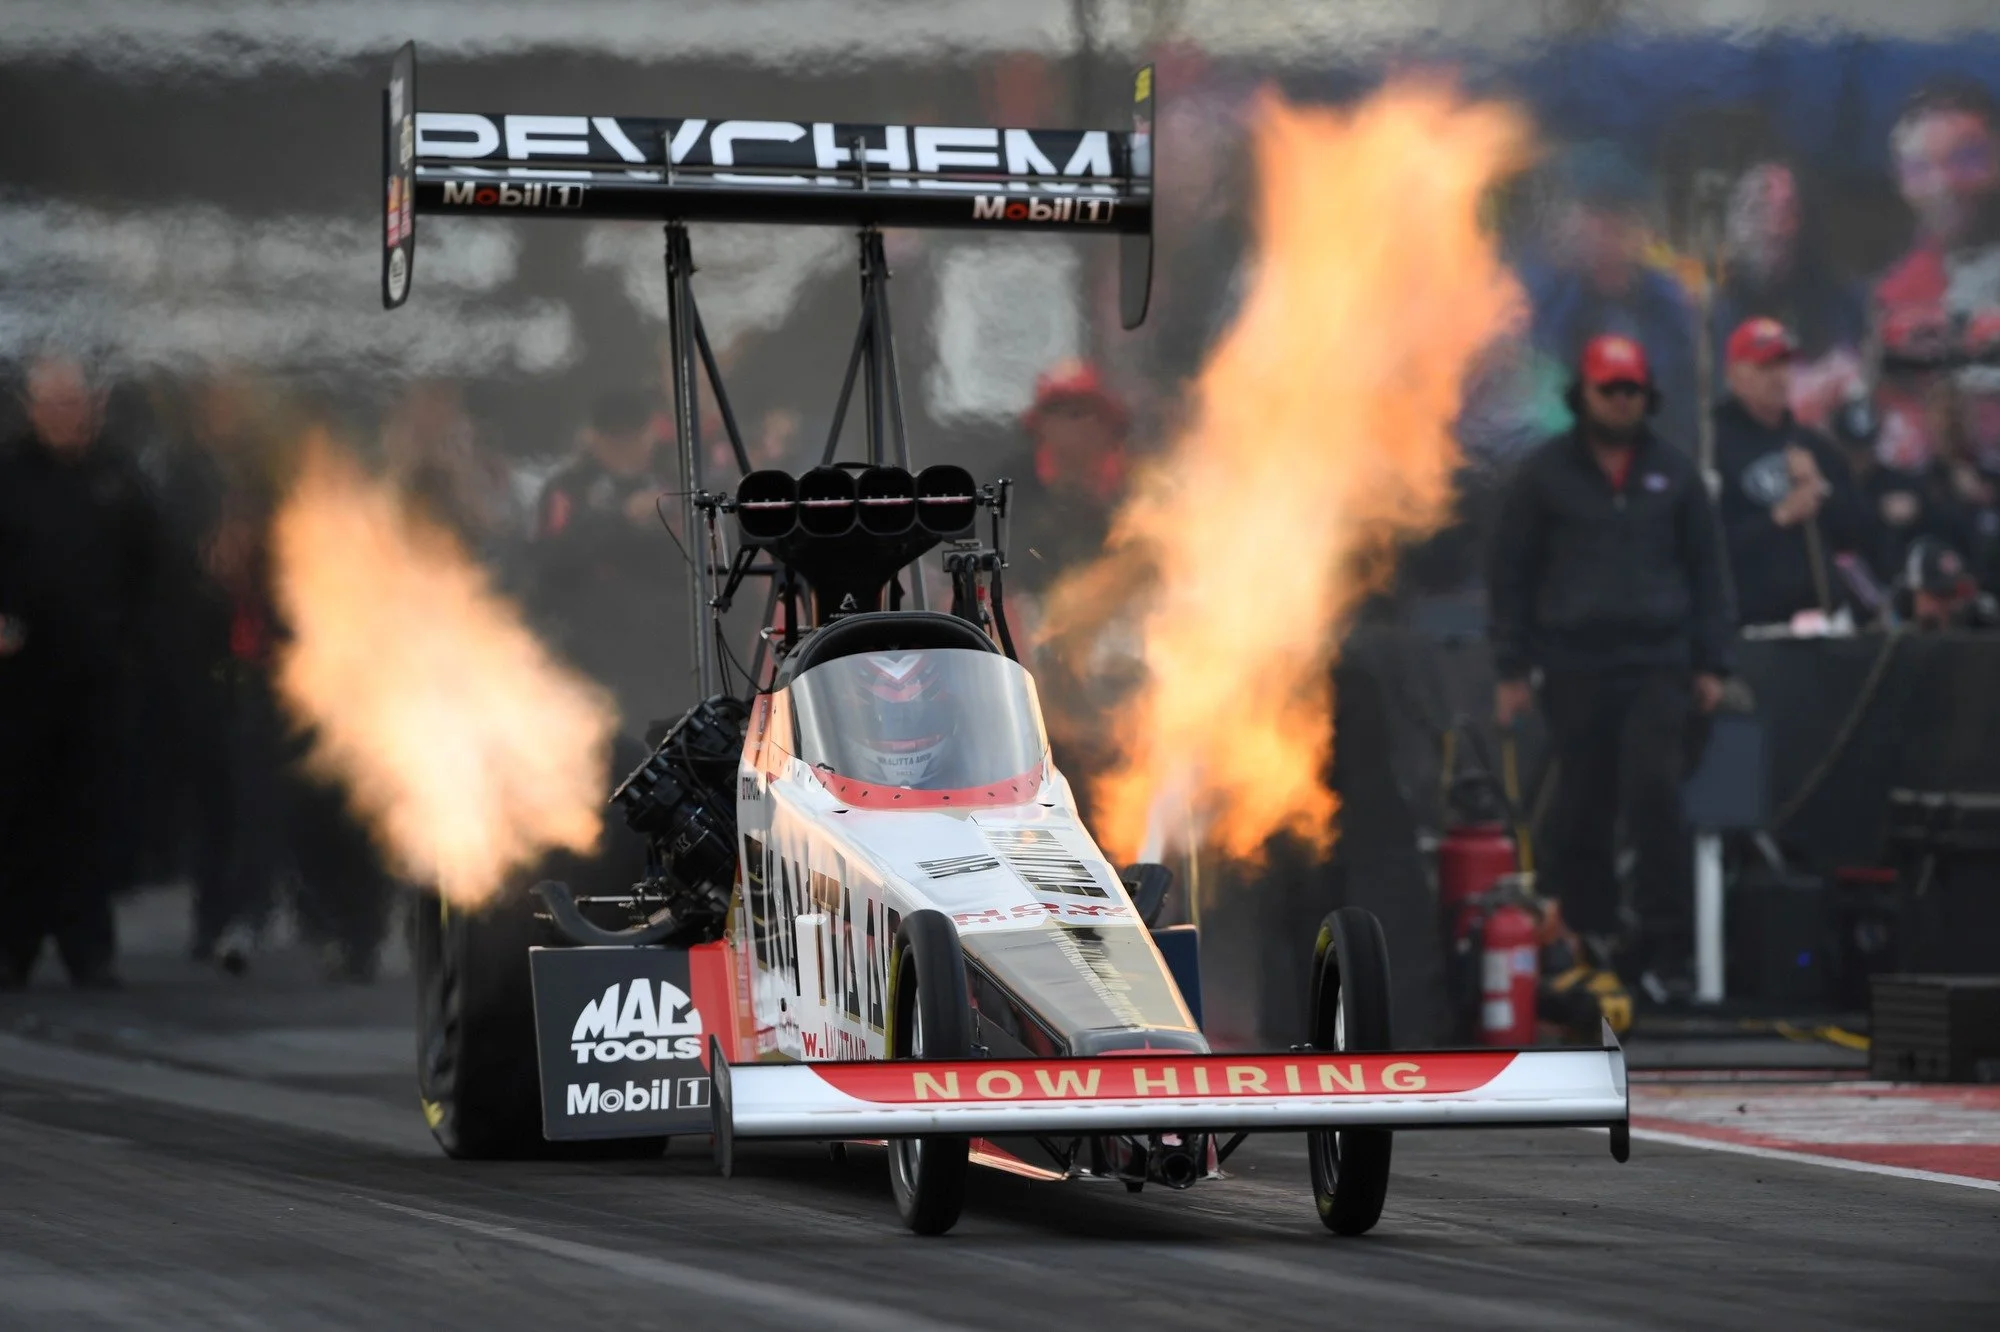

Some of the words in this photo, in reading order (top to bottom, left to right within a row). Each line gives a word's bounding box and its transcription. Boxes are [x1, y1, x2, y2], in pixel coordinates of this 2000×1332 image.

[443, 180, 542, 206] Mobil
[973, 195, 1072, 221] Mobil
[571, 977, 703, 1041] MAC
[570, 1037, 702, 1064] TOOLS
[567, 1078, 670, 1116] Mobil
[912, 1068, 1101, 1100] NOW
[1133, 1062, 1427, 1097] HIRING
